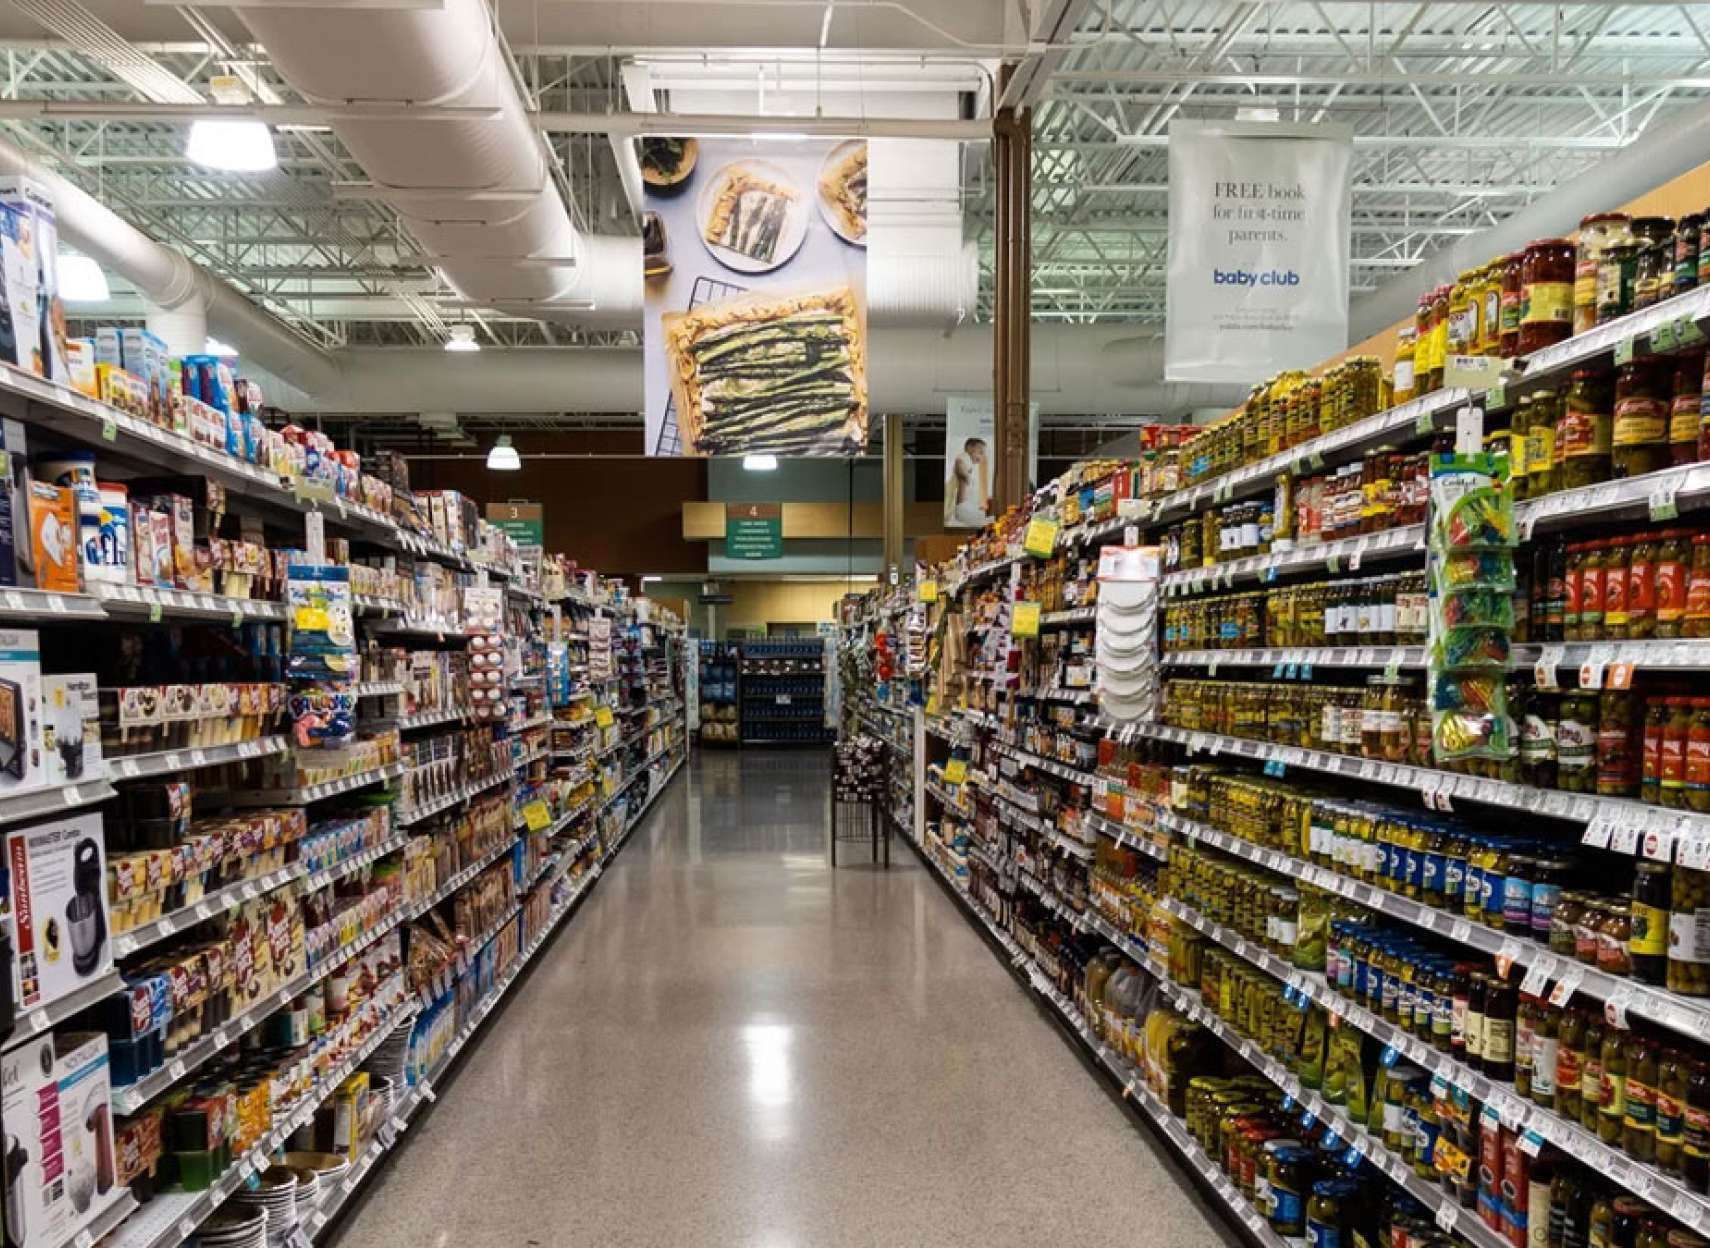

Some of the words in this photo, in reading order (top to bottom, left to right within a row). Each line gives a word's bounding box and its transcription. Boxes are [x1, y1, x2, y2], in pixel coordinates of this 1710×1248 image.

[1214, 182, 1264, 199] FREE
[1268, 183, 1305, 199] book
[1213, 204, 1233, 220] for
[1238, 204, 1306, 220] first-time
[1228, 229, 1288, 245] parents.
[1213, 269, 1258, 287] baby
[1260, 269, 1300, 286] club
[509, 505, 519, 519] 3
[749, 504, 759, 517] 4
